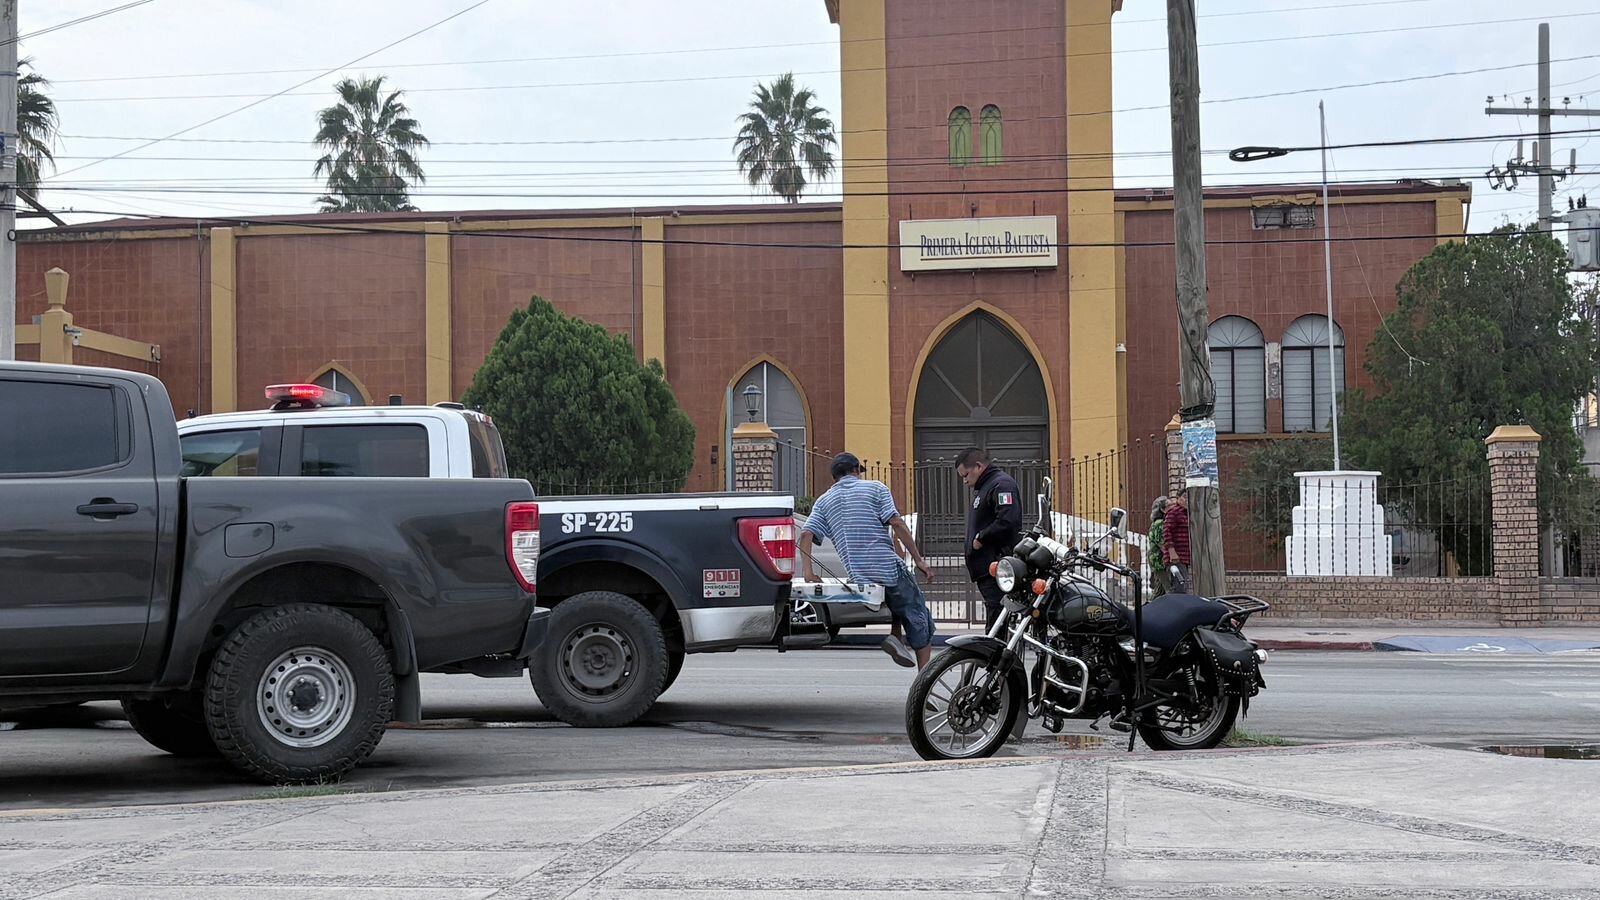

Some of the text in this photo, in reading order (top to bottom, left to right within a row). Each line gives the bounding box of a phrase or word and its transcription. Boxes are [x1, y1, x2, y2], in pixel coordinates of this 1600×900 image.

[920, 231, 1050, 257] PRIMERA IGLESIA BAUTISTA
[561, 512, 634, 534] SP-225
[706, 571, 737, 581] 911
